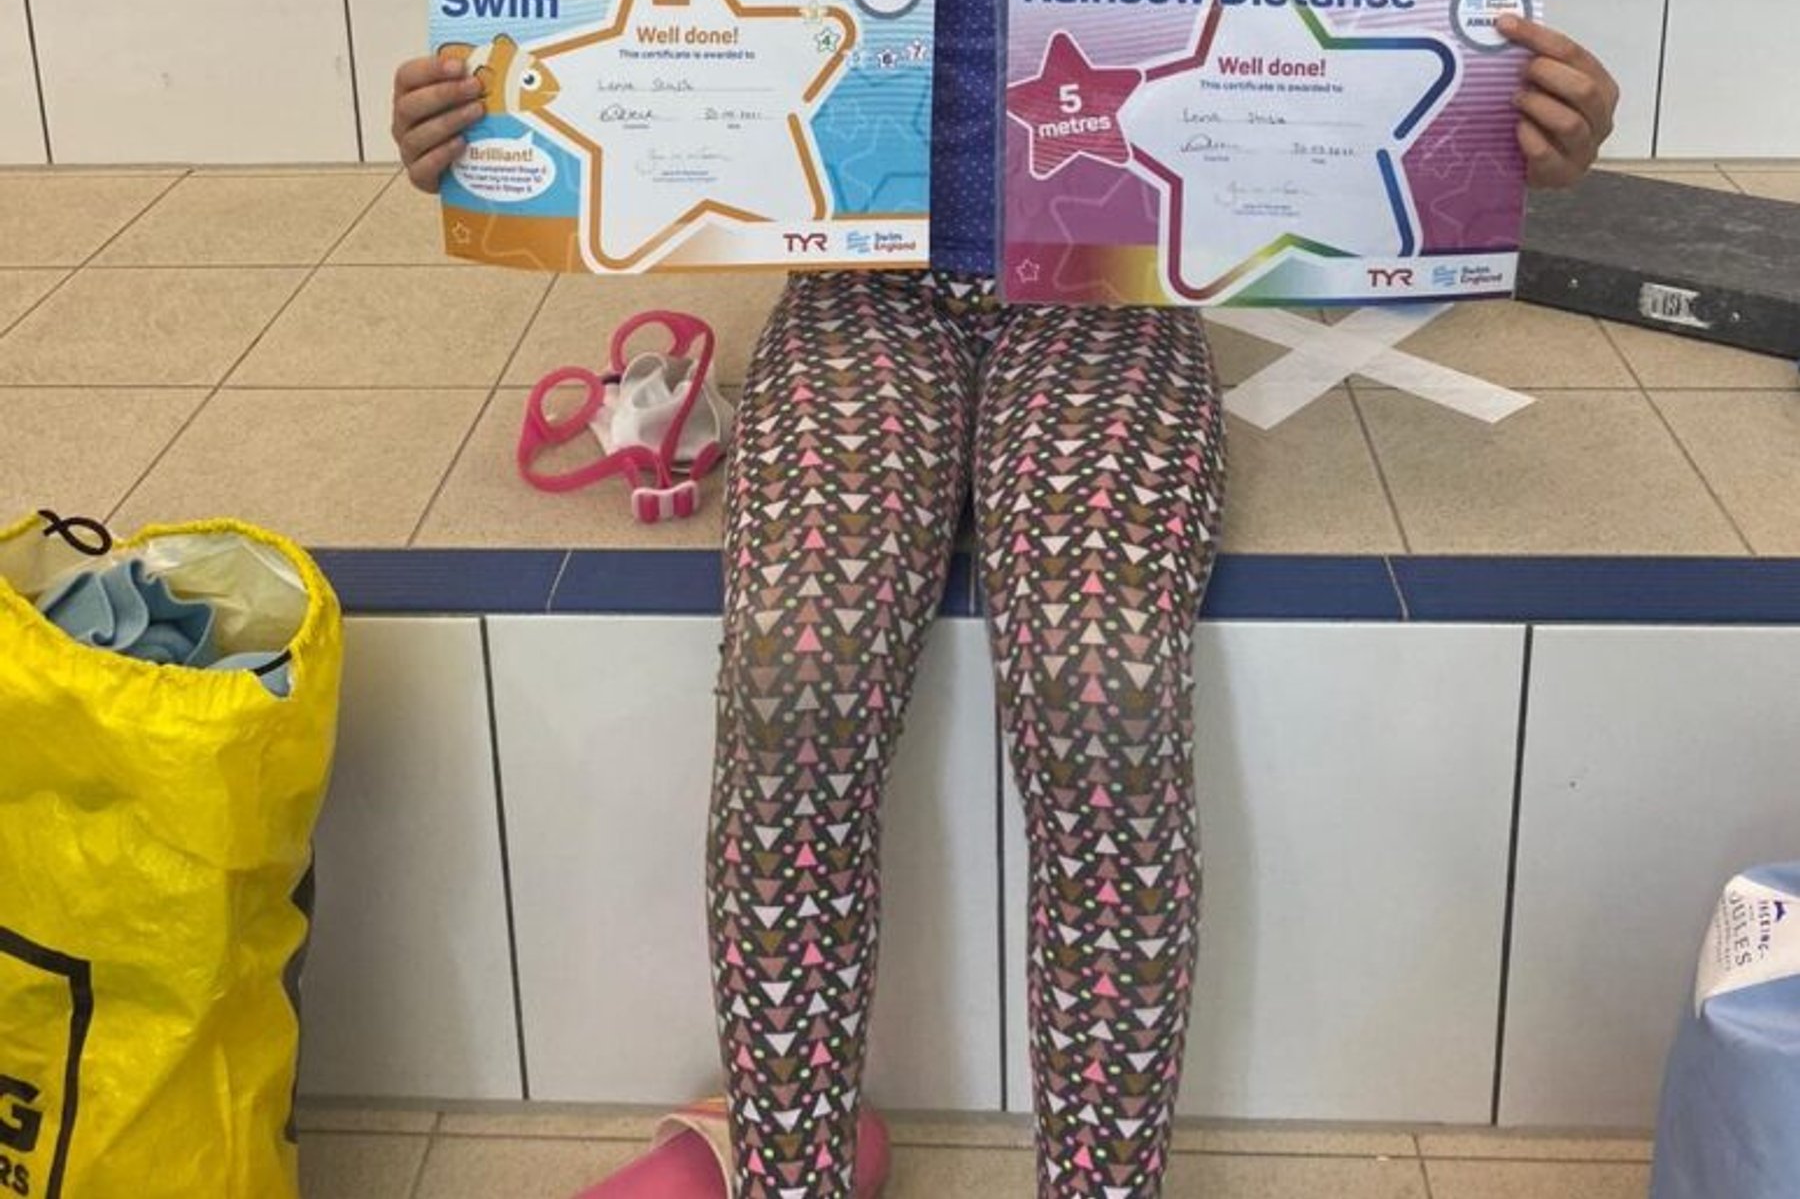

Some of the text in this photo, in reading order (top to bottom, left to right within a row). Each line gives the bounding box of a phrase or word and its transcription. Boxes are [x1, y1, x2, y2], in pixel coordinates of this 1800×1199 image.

[636, 26, 739, 44] Well done!
[619, 49, 639, 59] This
[641, 49, 691, 59] certificate
[703, 50, 743, 60] awarded
[745, 51, 755, 60] to
[1218, 57, 1326, 77] Well done!
[1201, 79, 1221, 90] This
[1223, 80, 1274, 92] certificate
[1287, 83, 1331, 93] awarded
[1332, 84, 1343, 94] to
[1059, 84, 1082, 113] 5
[1038, 114, 1112, 139] metres
[470, 147, 533, 162] Brilliant!
[783, 231, 828, 252] TYR
[874, 231, 903, 241] Swim
[873, 241, 917, 253] England
[1368, 267, 1413, 287] TYR
[1460, 273, 1503, 285] England
[1461, 265, 1490, 275] Swim
[1728, 890, 1752, 966] JULES
[0, 1072, 43, 1154] G
[0, 1154, 30, 1197] RS
